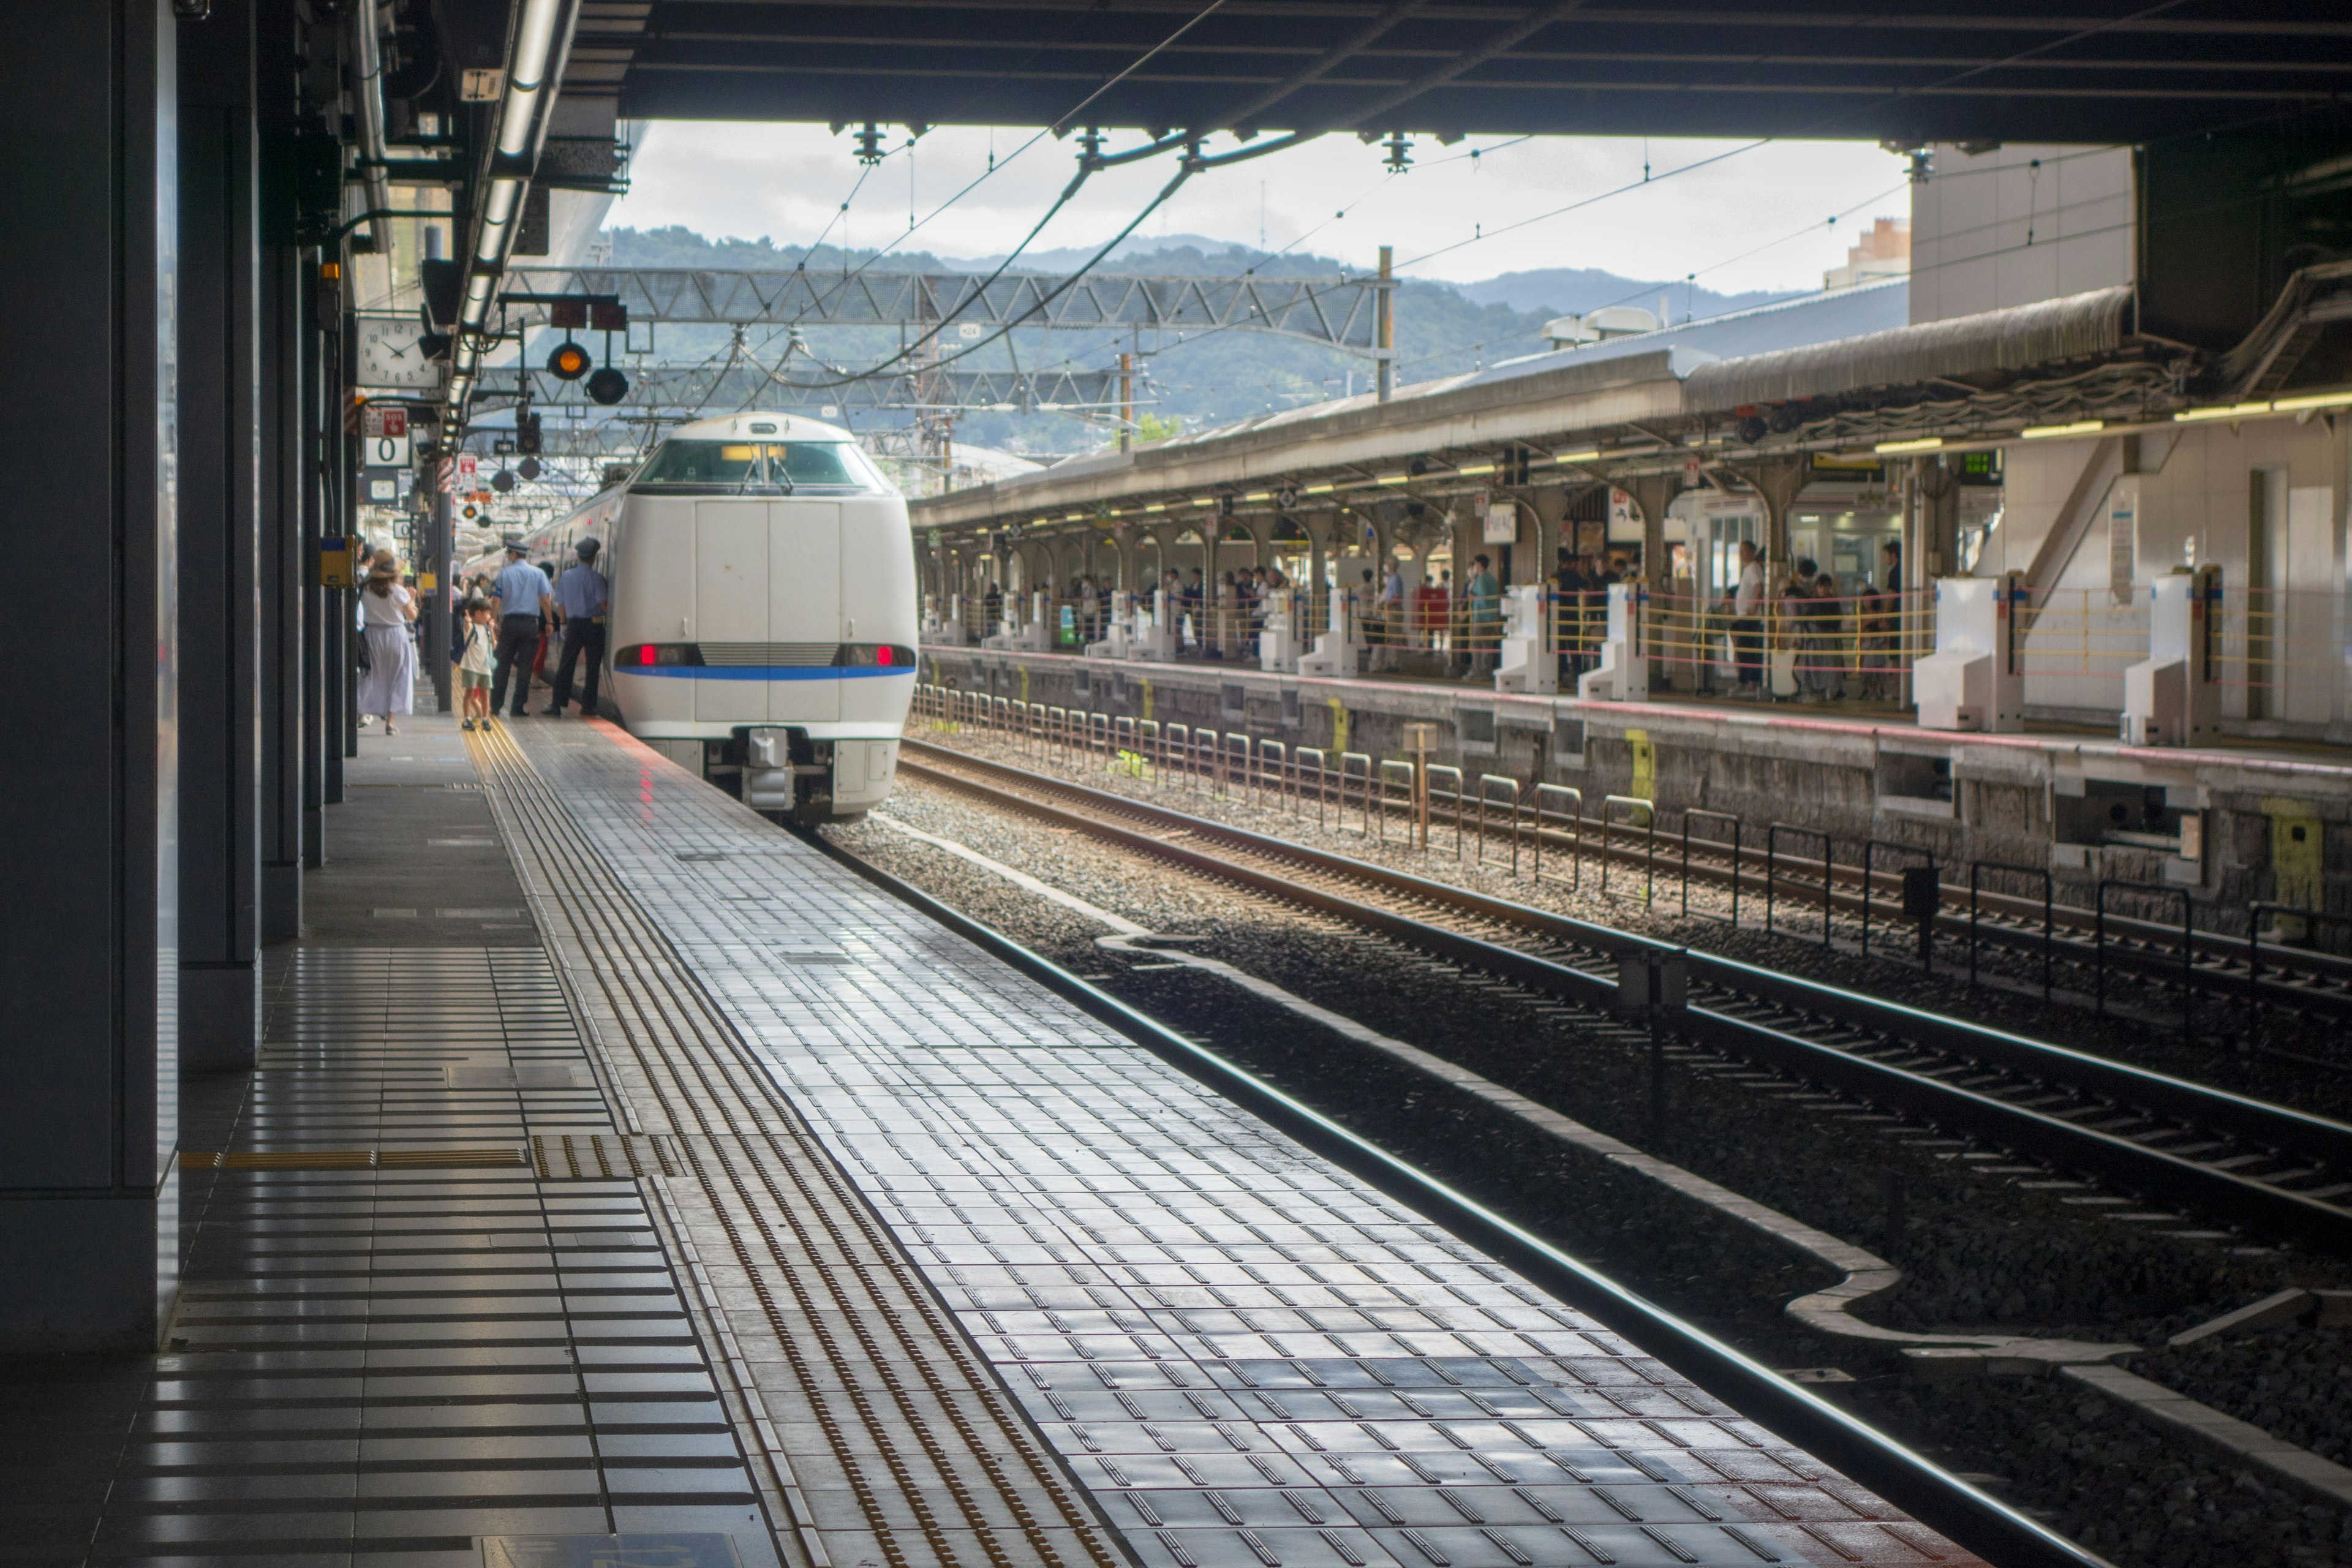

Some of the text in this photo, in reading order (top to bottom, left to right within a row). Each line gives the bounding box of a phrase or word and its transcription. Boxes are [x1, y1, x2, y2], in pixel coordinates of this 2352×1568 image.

[382, 323, 388, 336] 11
[395, 324, 402, 333] 12
[369, 334, 378, 343] 10
[365, 348, 371, 356] 9
[371, 362, 377, 371] 8
[420, 364, 424, 372] 4
[384, 370, 388, 379] 7
[395, 372, 400, 382] 6
[407, 371, 412, 380] 5
[379, 437, 395, 461] 0
